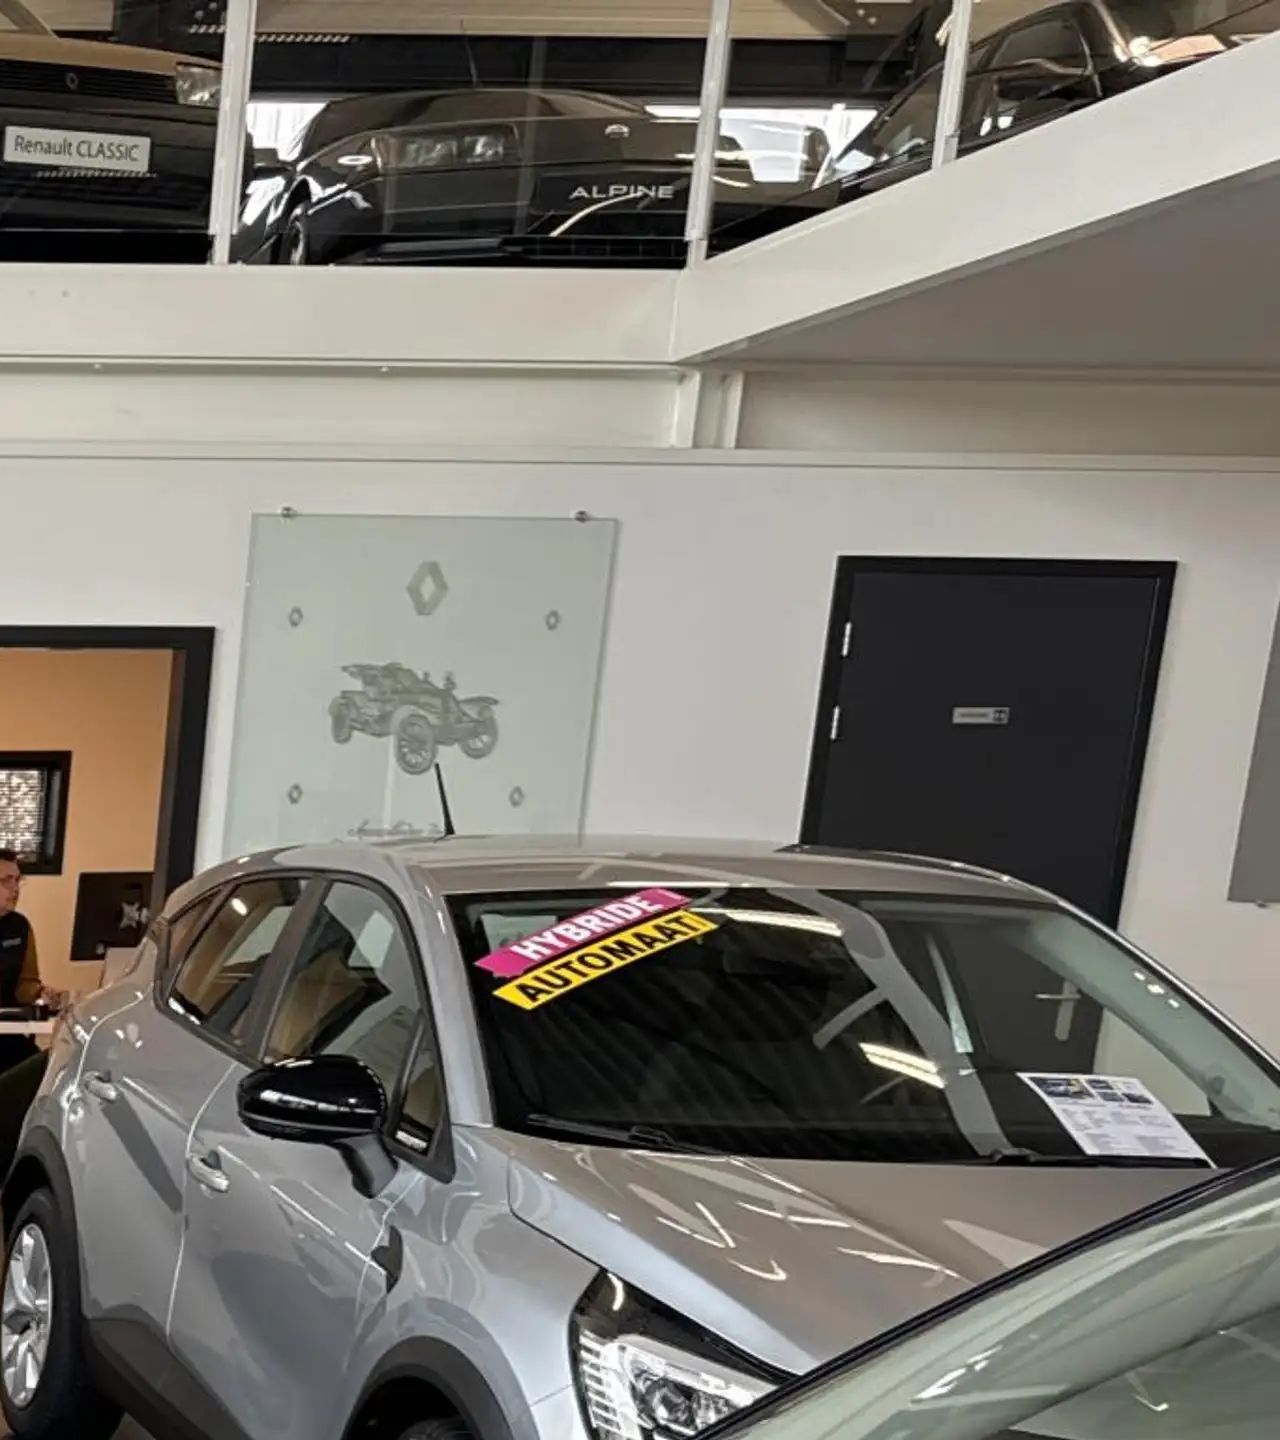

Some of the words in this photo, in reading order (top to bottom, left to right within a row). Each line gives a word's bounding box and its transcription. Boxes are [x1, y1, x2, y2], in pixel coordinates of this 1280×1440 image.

[14, 135, 72, 157] Renault
[76, 140, 140, 162] CLASSIC
[569, 185, 674, 199] ALPINE
[510, 894, 664, 961] HYBRIDE
[516, 915, 702, 1003] AUTOMAAT
